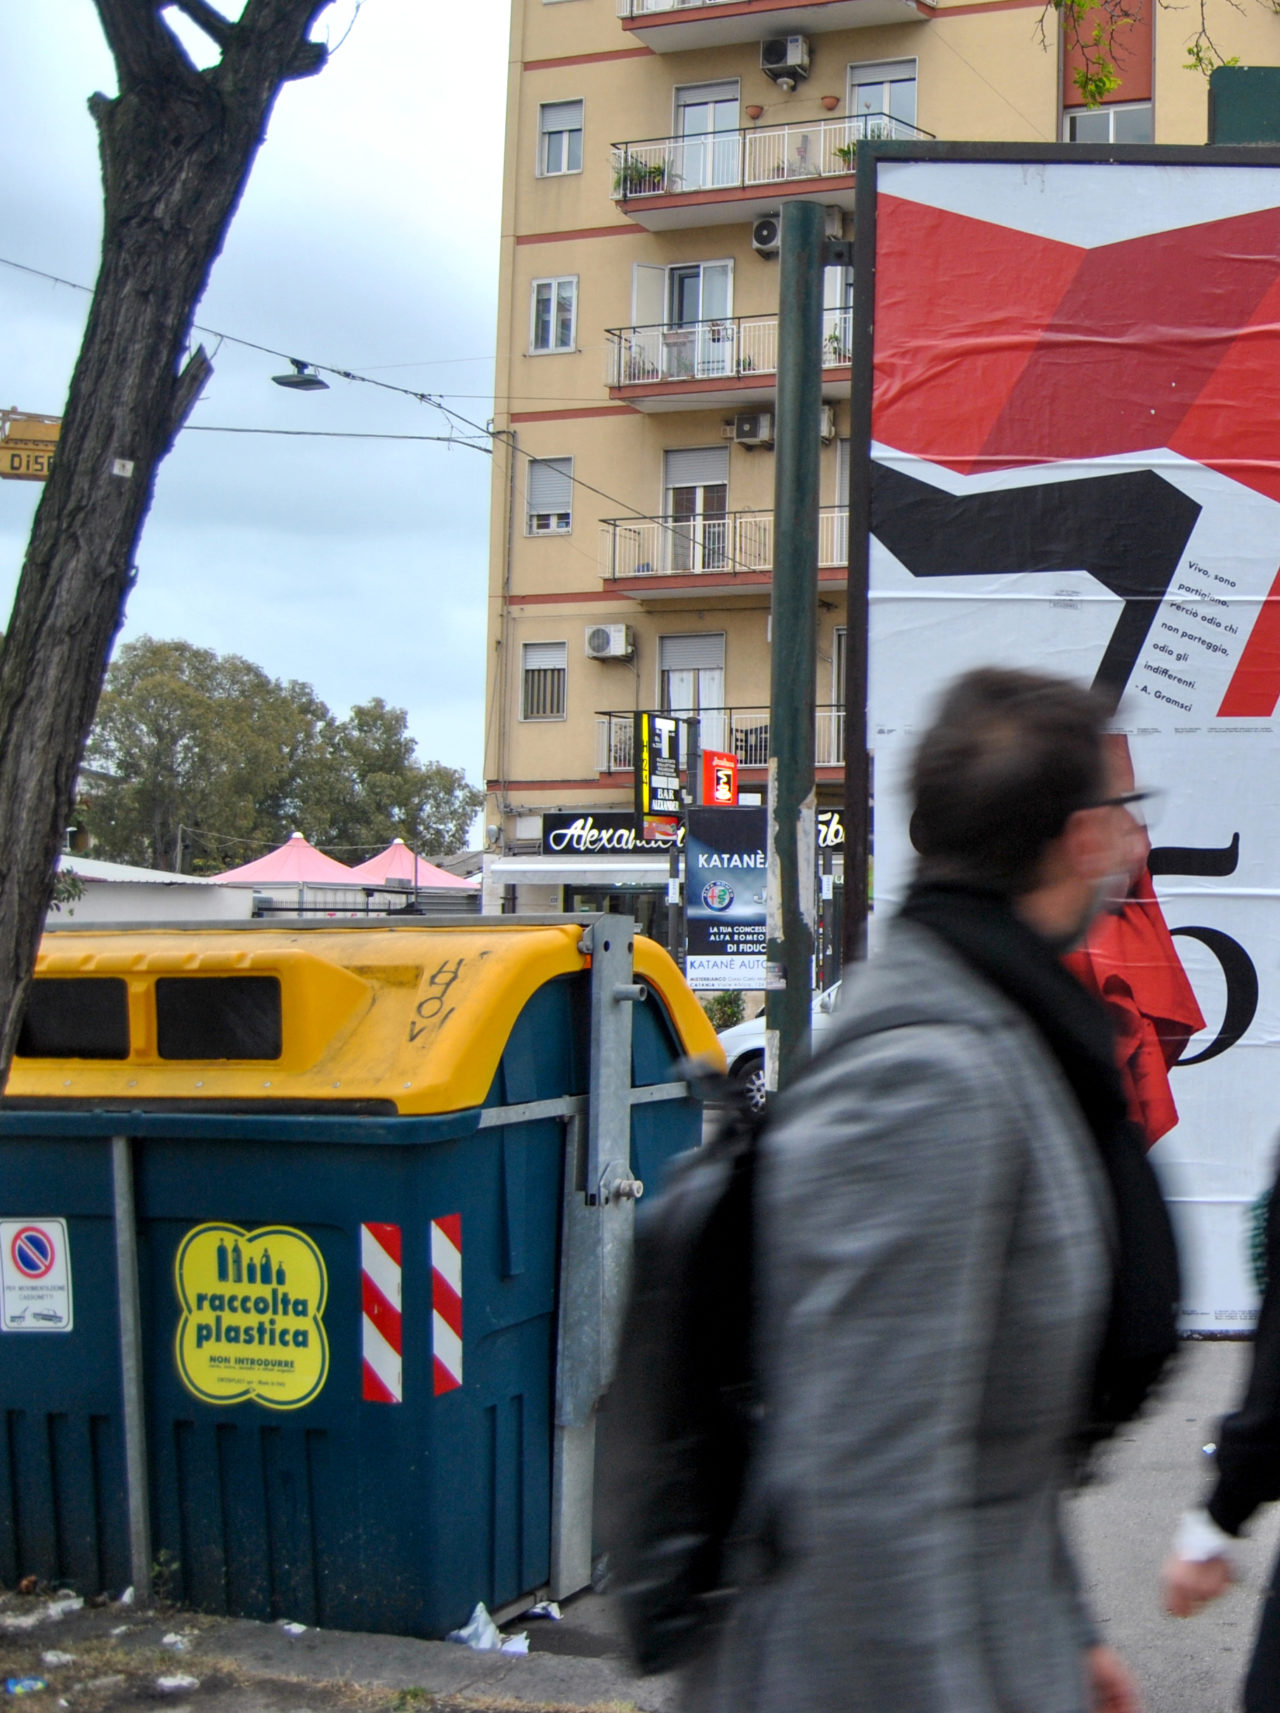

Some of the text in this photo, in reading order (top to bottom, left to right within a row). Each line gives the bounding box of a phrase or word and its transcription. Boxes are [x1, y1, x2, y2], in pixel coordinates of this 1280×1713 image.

[1188, 560, 1237, 588] Vivo, sono
[1200, 614, 1222, 629] odio
[1224, 623, 1239, 636] chi
[1161, 621, 1230, 657] non parteggia,
[1152, 642, 1190, 663] odio gli
[1153, 690, 1193, 713] Gramsci
[657, 789, 675, 800] BAR
[727, 944, 736, 952] DI
[196, 1287, 309, 1317] raccolta
[196, 1317, 310, 1349] plastica
[209, 1355, 231, 1365] NON
[234, 1357, 295, 1369] INTRODURRE
